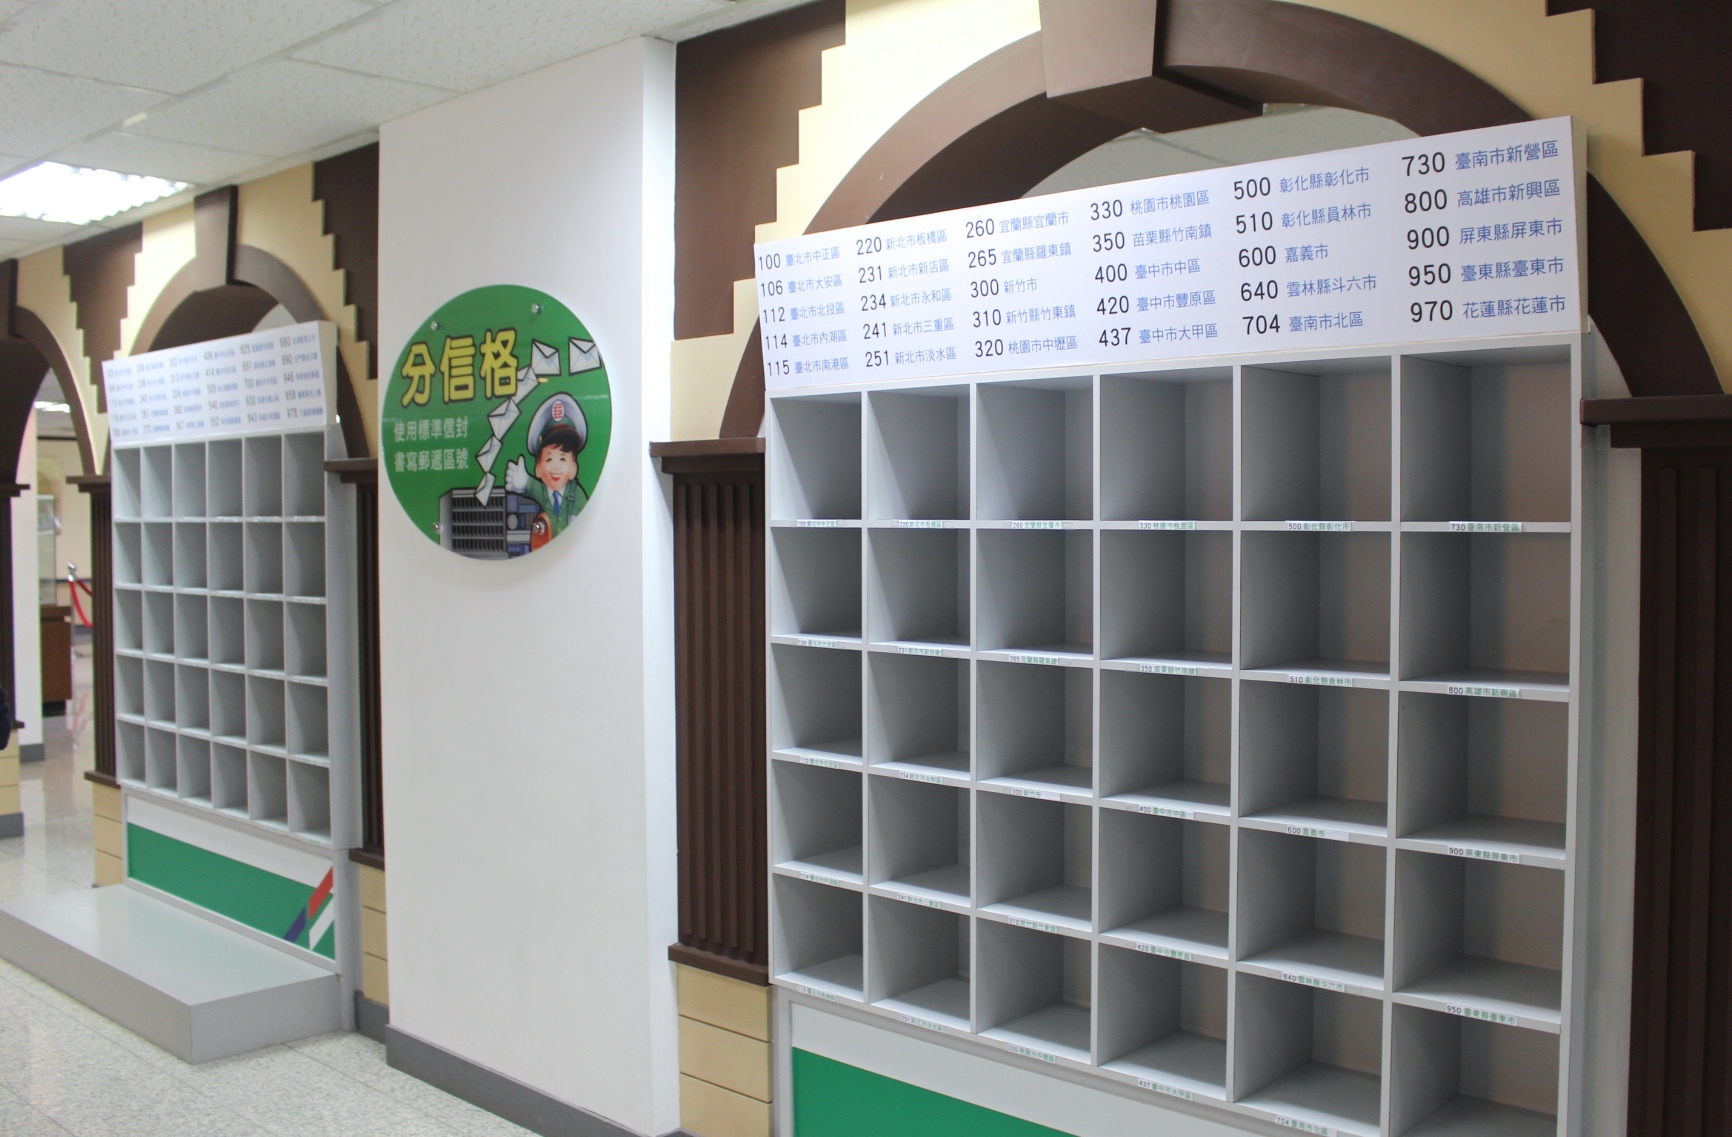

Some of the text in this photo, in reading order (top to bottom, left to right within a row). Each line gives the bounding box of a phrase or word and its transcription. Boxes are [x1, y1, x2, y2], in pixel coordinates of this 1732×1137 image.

[1402, 140, 1558, 176] 730 臺南市新營區
[1234, 167, 1369, 200] 500 彰化縣彰化市
[1405, 179, 1560, 213] 800 高雄市新興區
[1090, 190, 1210, 220] 330 桃園市桃園區
[966, 211, 1069, 238] 260 宜蘭縣宜蘭市
[1236, 202, 1371, 234] 510 彰化縣員林市
[856, 229, 947, 255] 220 新北市板橋區
[1093, 223, 1212, 252] 350 苗栗縣竹南鎮
[1407, 218, 1562, 249] 900 屏東縣屏東市
[759, 246, 840, 270] 100 臺北市中正區
[968, 242, 1071, 268] 265 宜蘭縣羅東鎮
[1238, 244, 1328, 267] 600 嘉義市
[859, 259, 949, 283] 231 新北市新店區
[1095, 258, 1200, 283] 400 臺中市中區
[1409, 256, 1564, 286] 950 臺東縣臺東市
[761, 274, 842, 297] 106 臺北市大安區
[970, 278, 1037, 298] 300 新竹市
[1241, 274, 1376, 301] 640 雲林縣斗六市
[861, 288, 951, 311] 234 新北市永和區
[1097, 290, 1216, 315] 420 臺中市豐原區
[1411, 295, 1565, 322] 970 花蓮縣花蓮市
[763, 302, 845, 323] 112 臺北市北投區
[973, 305, 1075, 327] 310 新竹縣竹東鎮
[1242, 311, 1363, 335] 704 臺南市北區
[765, 330, 847, 350] 114 臺北市內湖區
[863, 318, 954, 339] 241 新北市三重區
[1099, 323, 1218, 347] 437 臺中市大甲區
[865, 347, 956, 367] 251 新北市淡水區
[975, 336, 1078, 357] 320 桃園市中壢區
[402, 327, 518, 408] 分信格
[768, 357, 849, 376] 115 臺北市南港區
[394, 416, 468, 442] 使用標準信封
[1447, 1006, 1461, 1014] 950
